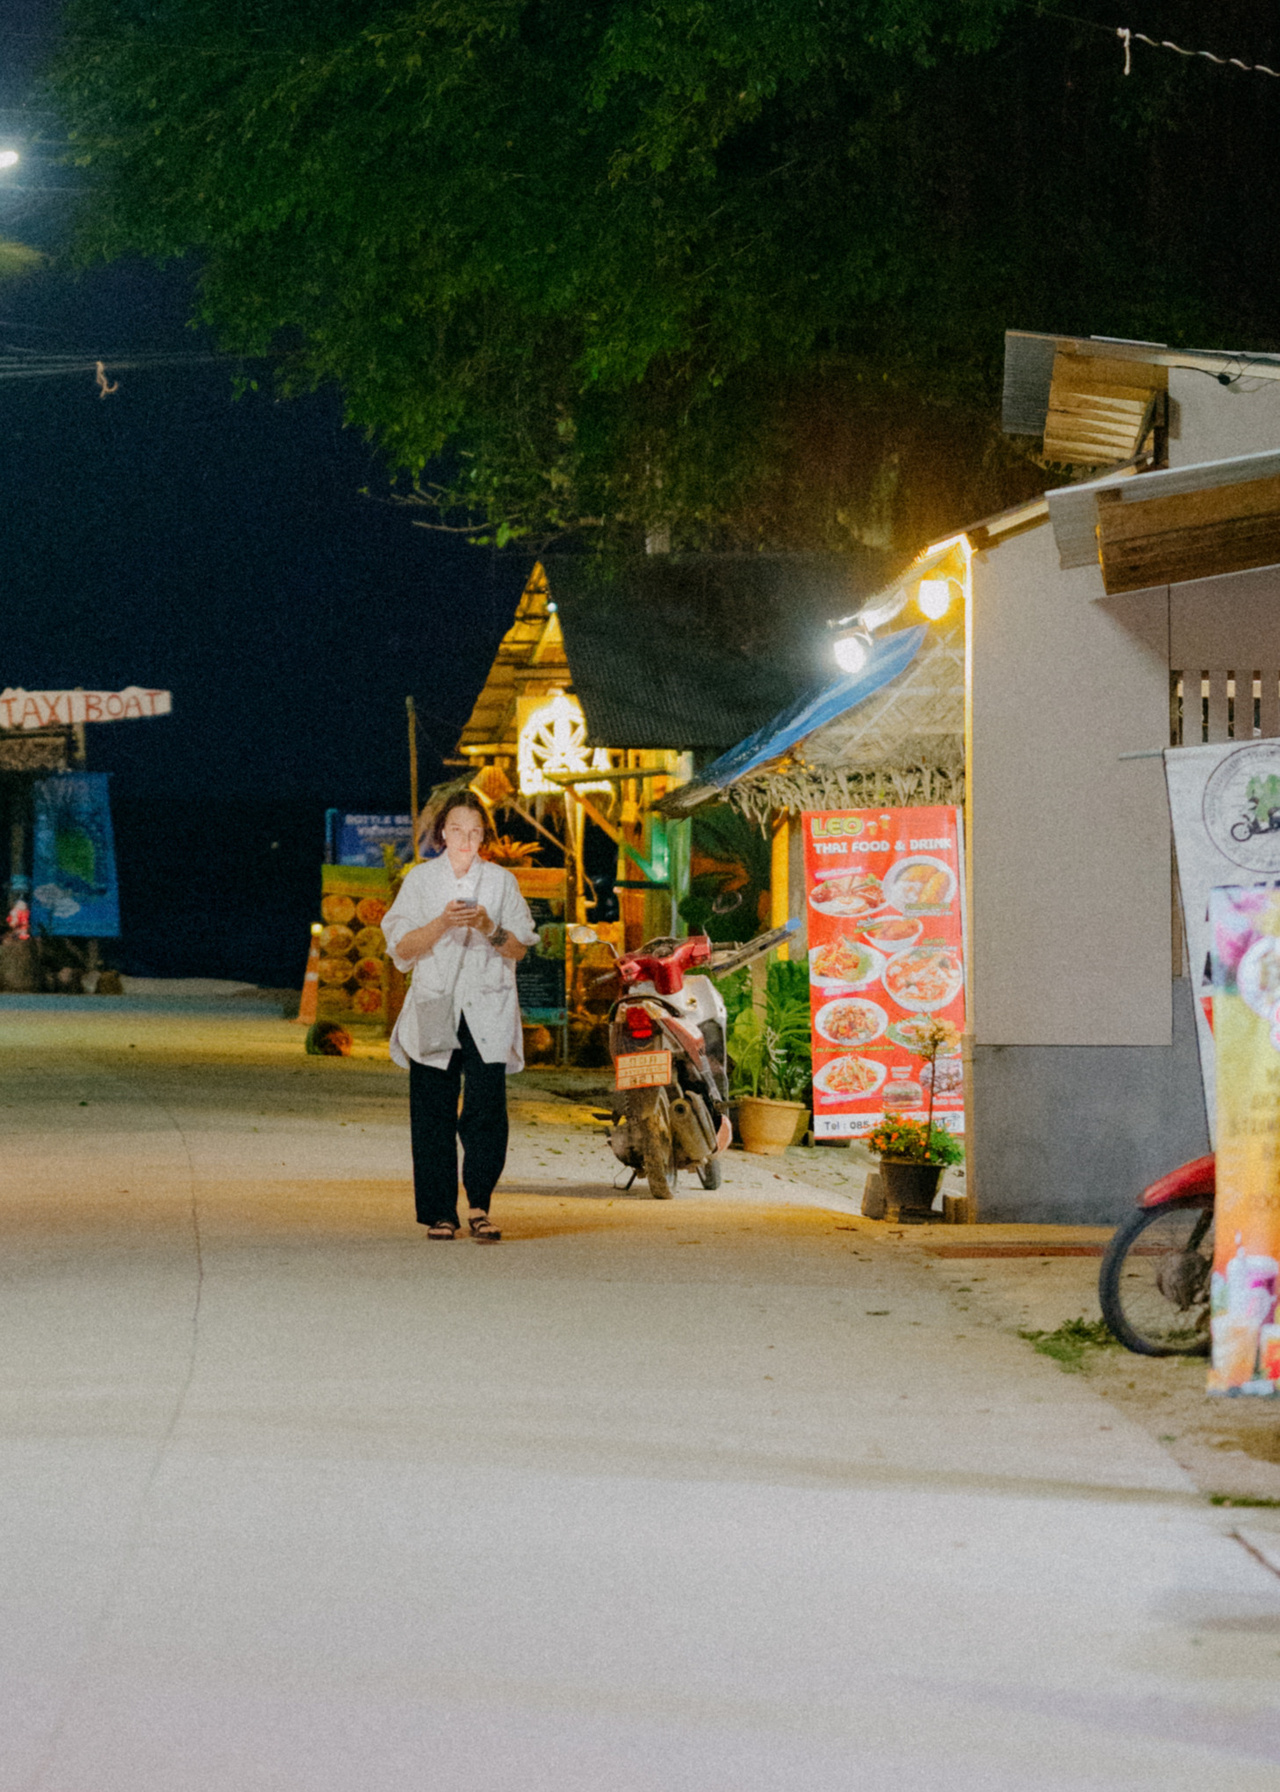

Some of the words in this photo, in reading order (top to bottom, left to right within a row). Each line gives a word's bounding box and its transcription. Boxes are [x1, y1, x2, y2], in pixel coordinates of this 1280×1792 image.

[1, 695, 74, 727] TAXI
[84, 692, 161, 722] BOAT
[811, 816, 864, 838] LEO
[813, 842, 848, 855] THAI
[852, 840, 890, 853] FOOD
[894, 839, 906, 851] &
[910, 838, 952, 851] DRINK
[824, 1120, 840, 1131] Tel
